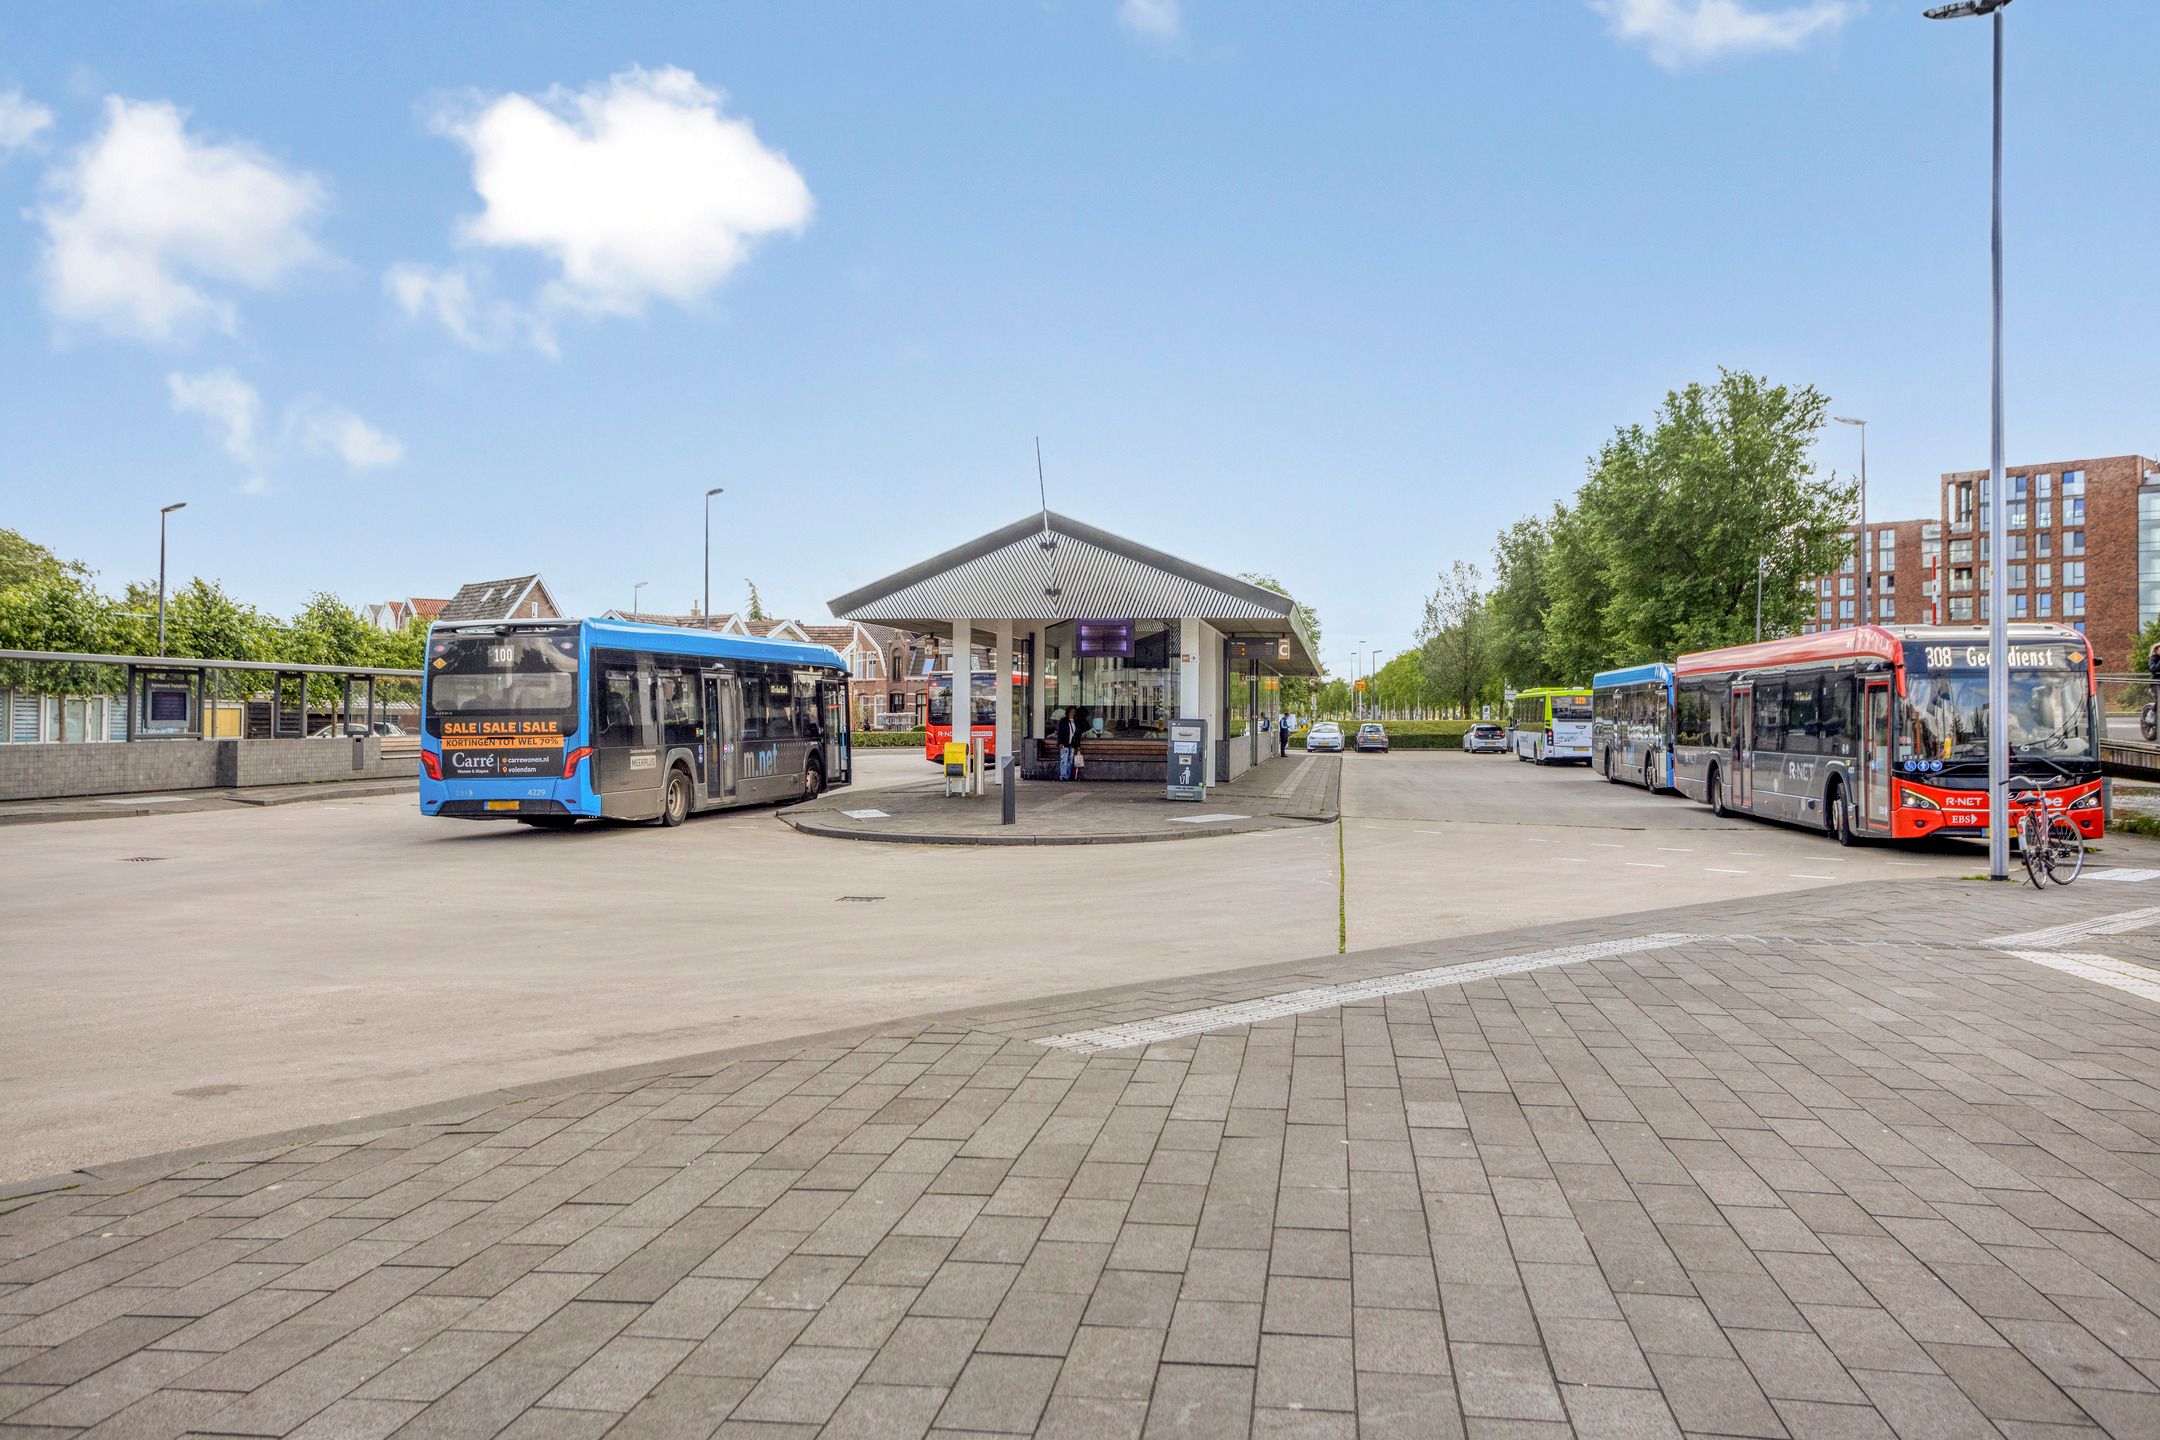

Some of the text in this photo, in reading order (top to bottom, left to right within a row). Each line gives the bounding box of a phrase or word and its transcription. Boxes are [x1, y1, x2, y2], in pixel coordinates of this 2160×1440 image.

[494, 648, 512, 662] 100
[1278, 644, 1288, 656] C
[1925, 646, 1951, 668] 308
[2008, 646, 2053, 667] dienst
[445, 721, 558, 734] SALE SALE SALE
[446, 736, 559, 747] KORTINGEN TOT WEL 70%
[452, 751, 495, 768] Carré
[507, 756, 550, 764] carrewonen.nl
[631, 757, 655, 769] MEERPLUS
[508, 766, 537, 774] volendam
[1951, 815, 1970, 824] EBS
